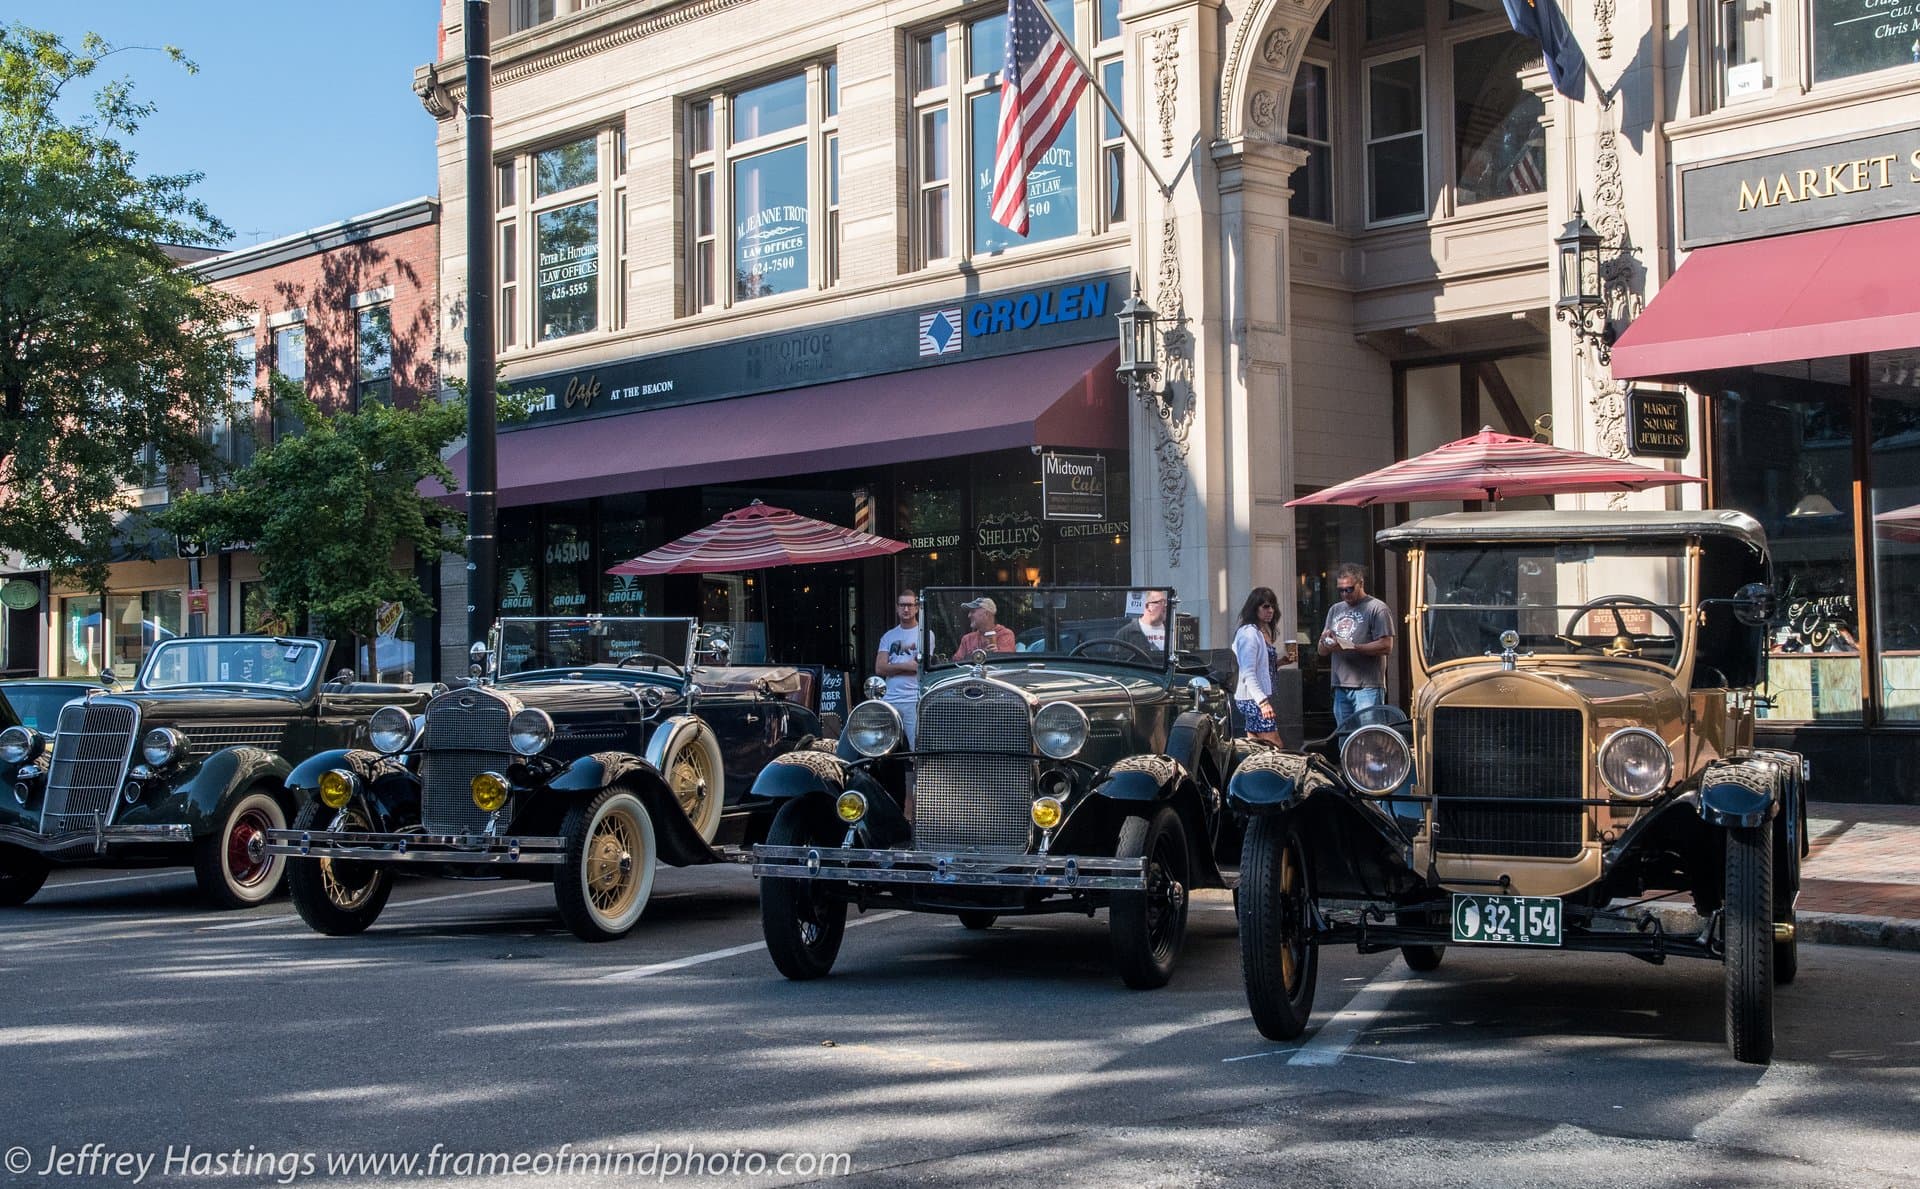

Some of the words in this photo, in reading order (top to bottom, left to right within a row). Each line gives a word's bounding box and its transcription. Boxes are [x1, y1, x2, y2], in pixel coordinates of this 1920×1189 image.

[1875, 22, 1908, 38] Chris
[1030, 183, 1041, 196] AT
[1043, 179, 1061, 193] LAW
[1737, 154, 1898, 212] MARKET
[746, 206, 781, 234] JEANNE
[540, 252, 559, 266] PETER
[743, 246, 761, 259] LAW
[543, 269, 560, 283] LAW
[562, 261, 597, 279] OFFICES
[752, 256, 795, 276] 624-7500
[967, 282, 1110, 338] GROLEN
[564, 375, 601, 409] Cafe
[610, 388, 621, 401] AT
[623, 385, 640, 399] THE
[642, 380, 673, 396] BEACON
[1643, 402, 1677, 416] MARKET
[1643, 418, 1677, 431] SQUARE
[1640, 432, 1684, 446] JEWELERS
[1047, 457, 1093, 476] Midtown
[979, 525, 1040, 546] SHELLEY'S
[1060, 521, 1129, 538] GENTLEMEN'S
[936, 535, 960, 547] SHOP
[502, 598, 534, 609] GROLEN
[553, 594, 587, 606] GROLEN
[608, 591, 643, 603] GROLEN
[1484, 934, 1530, 942] 1926
